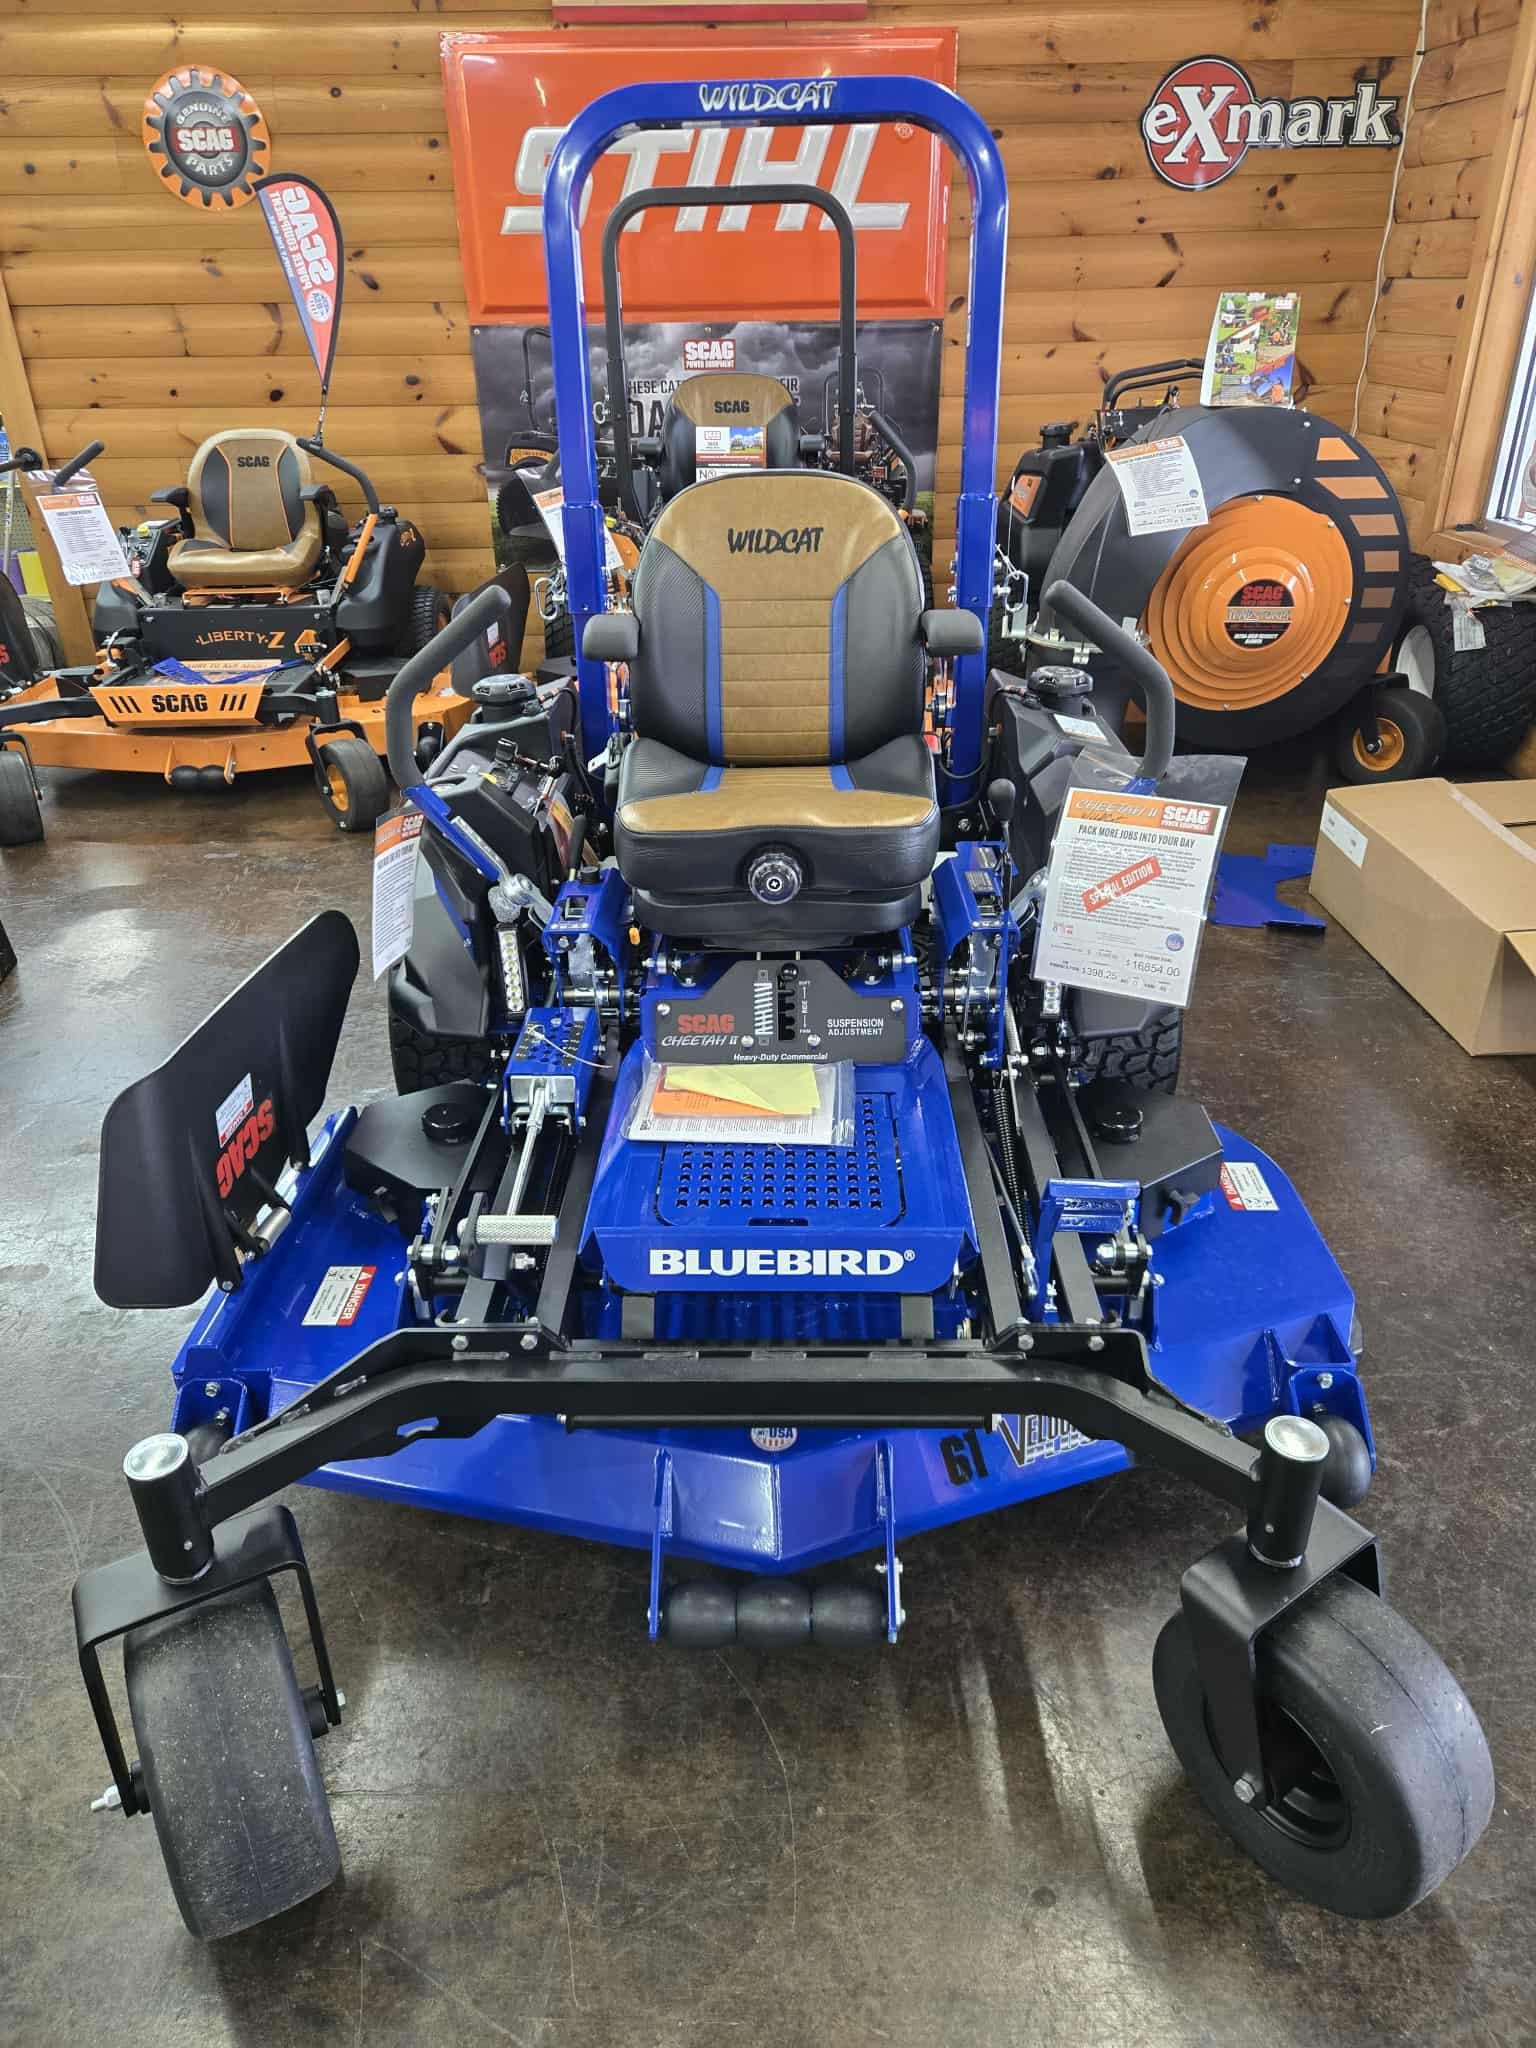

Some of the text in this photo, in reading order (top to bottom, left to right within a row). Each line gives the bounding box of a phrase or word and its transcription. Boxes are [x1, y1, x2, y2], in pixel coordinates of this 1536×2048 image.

[699, 81, 837, 112] WILDCAT
[177, 103, 232, 125] GENUINE
[1146, 84, 1396, 163] eXmark
[177, 128, 234, 151] SCAG
[185, 153, 234, 176] PARTS
[685, 341, 735, 360] SCAG
[628, 380, 658, 394] HESE
[660, 380, 682, 394] CAT
[714, 401, 750, 415] SCAG
[238, 456, 271, 468] SCAG
[727, 527, 824, 554] WILDCAT
[1241, 585, 1284, 601] SCAG
[152, 694, 209, 713] SCAG
[1162, 805, 1211, 825] SCAG
[1078, 824, 1196, 848] PACK MORE JOBS INTO YOUR DAY
[1121, 862, 1155, 888] EDITION
[678, 1014, 735, 1034] SCAG
[827, 1018, 884, 1028] SUSPENSION
[828, 1028, 883, 1036] ADJUSTMENT
[661, 1035, 739, 1047] CHEETAH II
[733, 1052, 828, 1063] Heavy-Duty Commercial
[216, 1098, 276, 1199] SCAG
[340, 1282, 364, 1321] DANGER
[939, 1430, 990, 1487] 61
